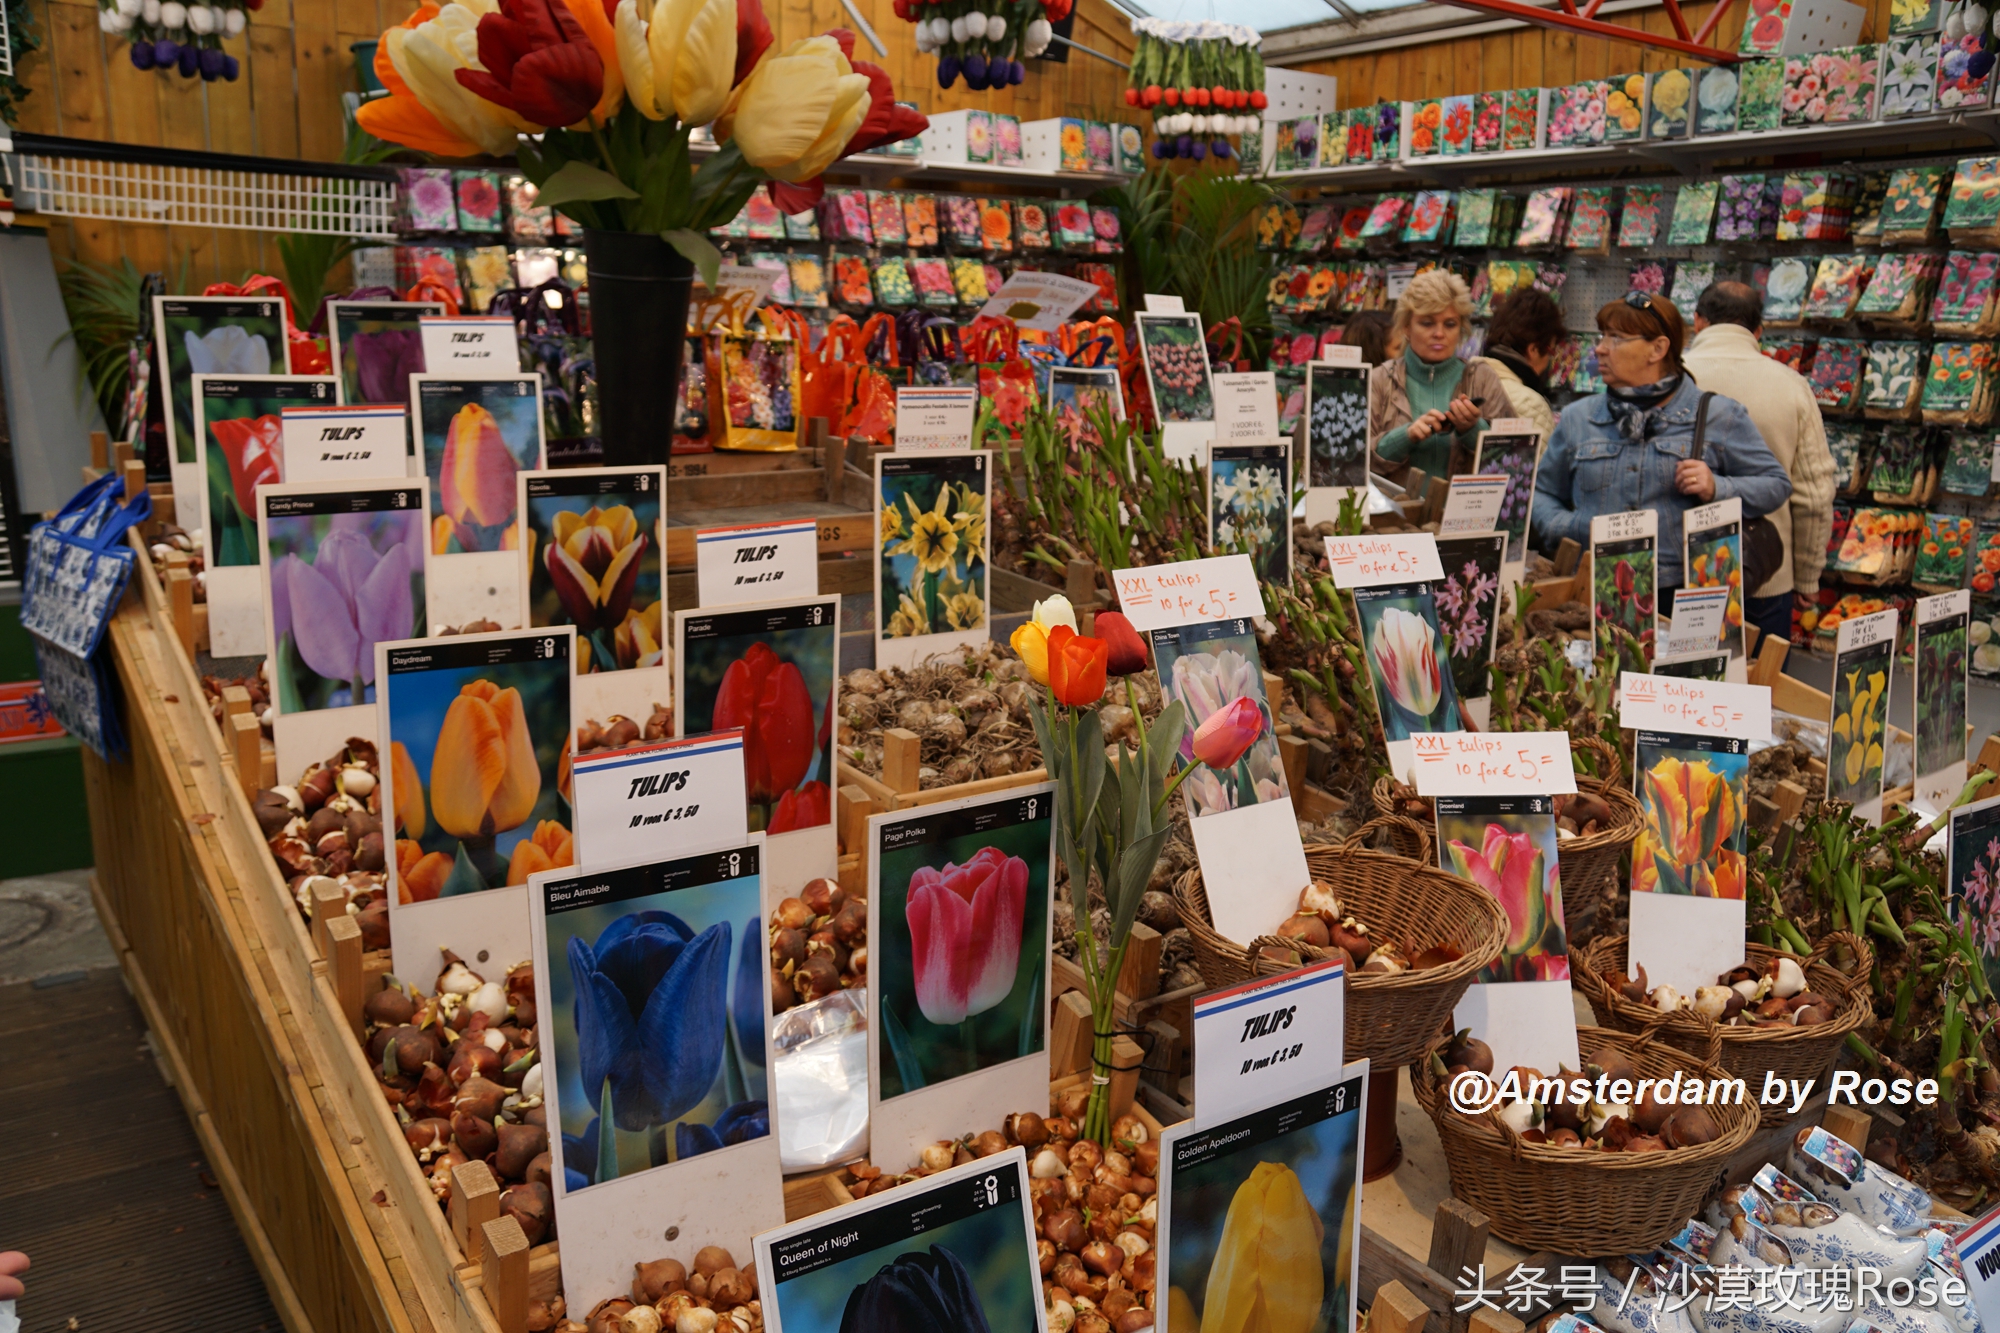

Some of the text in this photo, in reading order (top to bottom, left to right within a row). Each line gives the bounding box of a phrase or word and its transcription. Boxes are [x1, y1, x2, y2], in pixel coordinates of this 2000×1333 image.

[450, 332, 485, 343] TULIPS
[320, 427, 365, 441] TULIPS
[320, 453, 330, 461] 10
[733, 545, 778, 564] TULIPS
[1329, 540, 1392, 557] XXL tulips
[1359, 563, 1371, 575] 10
[1374, 561, 1387, 576] for
[734, 576, 744, 586] 10
[1120, 572, 1201, 594] XXL tulips
[1160, 598, 1172, 610] 10
[1178, 595, 1193, 617] for
[688, 624, 711, 632] Parade
[392, 655, 432, 665] Daydream
[1629, 678, 1705, 701] XXL tulips
[1663, 704, 1676, 714] 10
[1682, 703, 1698, 719] for
[1414, 736, 1502, 755] XXL tulips
[1456, 763, 1471, 776] 10
[1478, 762, 1499, 783] for
[627, 770, 690, 800] TULIPS
[629, 815, 643, 828] 10
[663, 809, 673, 822] €
[884, 827, 926, 843] Page Polka
[550, 883, 610, 903] Bleu Aimable
[1240, 1005, 1297, 1043] TULIPS
[1240, 1059, 1252, 1075] 10
[1271, 1050, 1279, 1065] €
[1178, 1128, 1251, 1161] Golden Apeldoorn
[779, 1231, 860, 1267] Queen of Night
[789, 1241, 802, 1251] single
